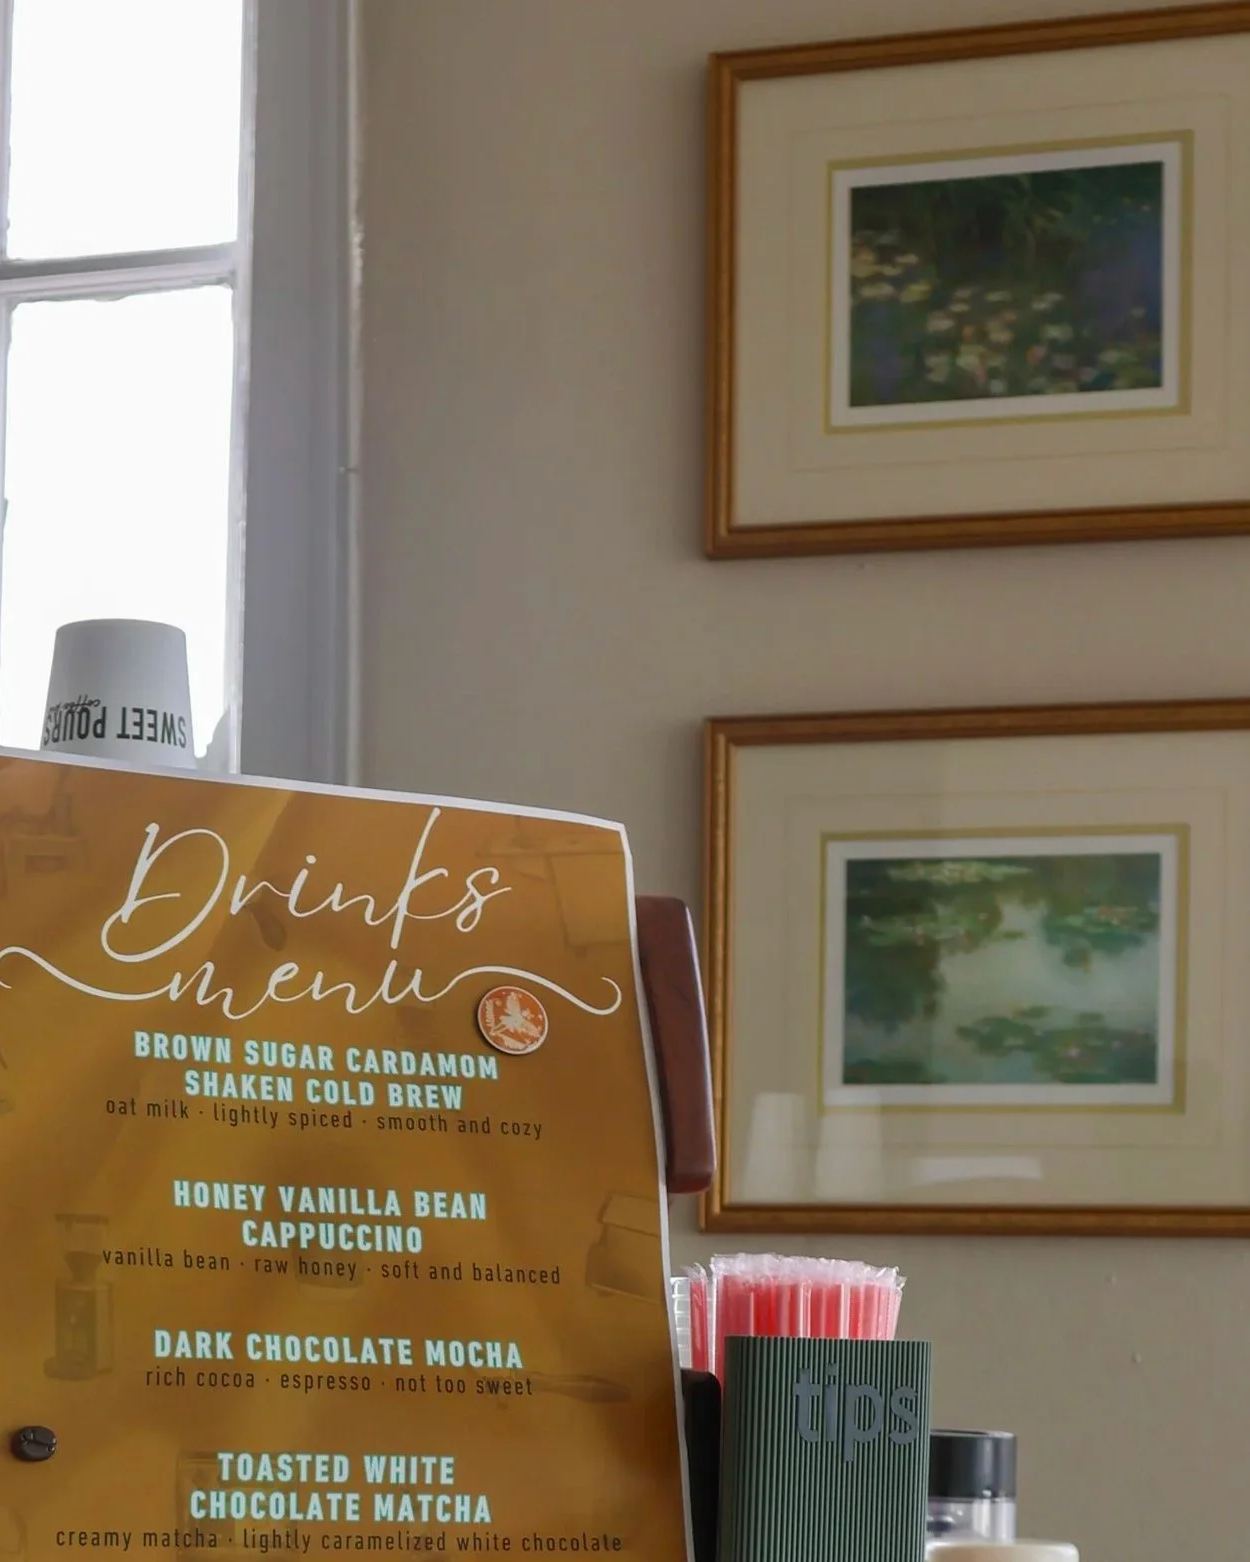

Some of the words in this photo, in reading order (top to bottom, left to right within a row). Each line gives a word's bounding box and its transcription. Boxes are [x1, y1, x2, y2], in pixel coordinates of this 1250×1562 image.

[43, 706, 106, 746] POURS
[116, 707, 186, 748] SWEET
[100, 807, 512, 963] Drinks
[134, 1031, 232, 1063] BROWN
[244, 1039, 334, 1071] SUGAR
[346, 1047, 498, 1080] CARDAMOM
[184, 1069, 294, 1102] SHAKEN
[306, 1078, 375, 1106] COLD
[387, 1083, 462, 1109] BREW
[106, 1098, 136, 1115] oat
[147, 1100, 189, 1119] milk
[213, 1102, 278, 1129] lightly
[288, 1110, 352, 1130] spiced
[377, 1114, 448, 1133] smooth
[457, 1117, 491, 1134] and
[501, 1121, 542, 1140] cozy
[173, 1180, 266, 1212] HONEY
[278, 1186, 401, 1217] VANILLA
[414, 1190, 486, 1220] BEAN
[242, 1219, 422, 1254] CAPPUCCINO
[102, 1247, 174, 1267] vanilla
[183, 1249, 230, 1271] bean
[254, 1258, 288, 1274] raw
[299, 1256, 356, 1281] honey
[381, 1260, 419, 1280] soft
[429, 1262, 463, 1281] and
[472, 1263, 560, 1285] balanced
[154, 1329, 234, 1360] DARK
[246, 1333, 413, 1366] CHOCOLATE
[425, 1339, 523, 1369] MOCHA
[146, 1366, 186, 1386] rich
[196, 1371, 255, 1388] cocoa
[281, 1372, 371, 1394] espresso
[396, 1374, 426, 1392] not
[436, 1375, 466, 1394] too
[476, 1377, 533, 1396] sweet
[792, 1363, 918, 1463] tips
[217, 1452, 350, 1483] TOASTED
[363, 1455, 455, 1485] WHITE
[190, 1490, 360, 1522] CHOCOLATE
[374, 1493, 492, 1523] MATCHA
[56, 1529, 132, 1551] creamy
[143, 1528, 217, 1548] matcha
[243, 1528, 311, 1554] lightly
[321, 1531, 446, 1551] caramelized
[456, 1532, 511, 1551] white
[522, 1532, 622, 1551] chocolate
